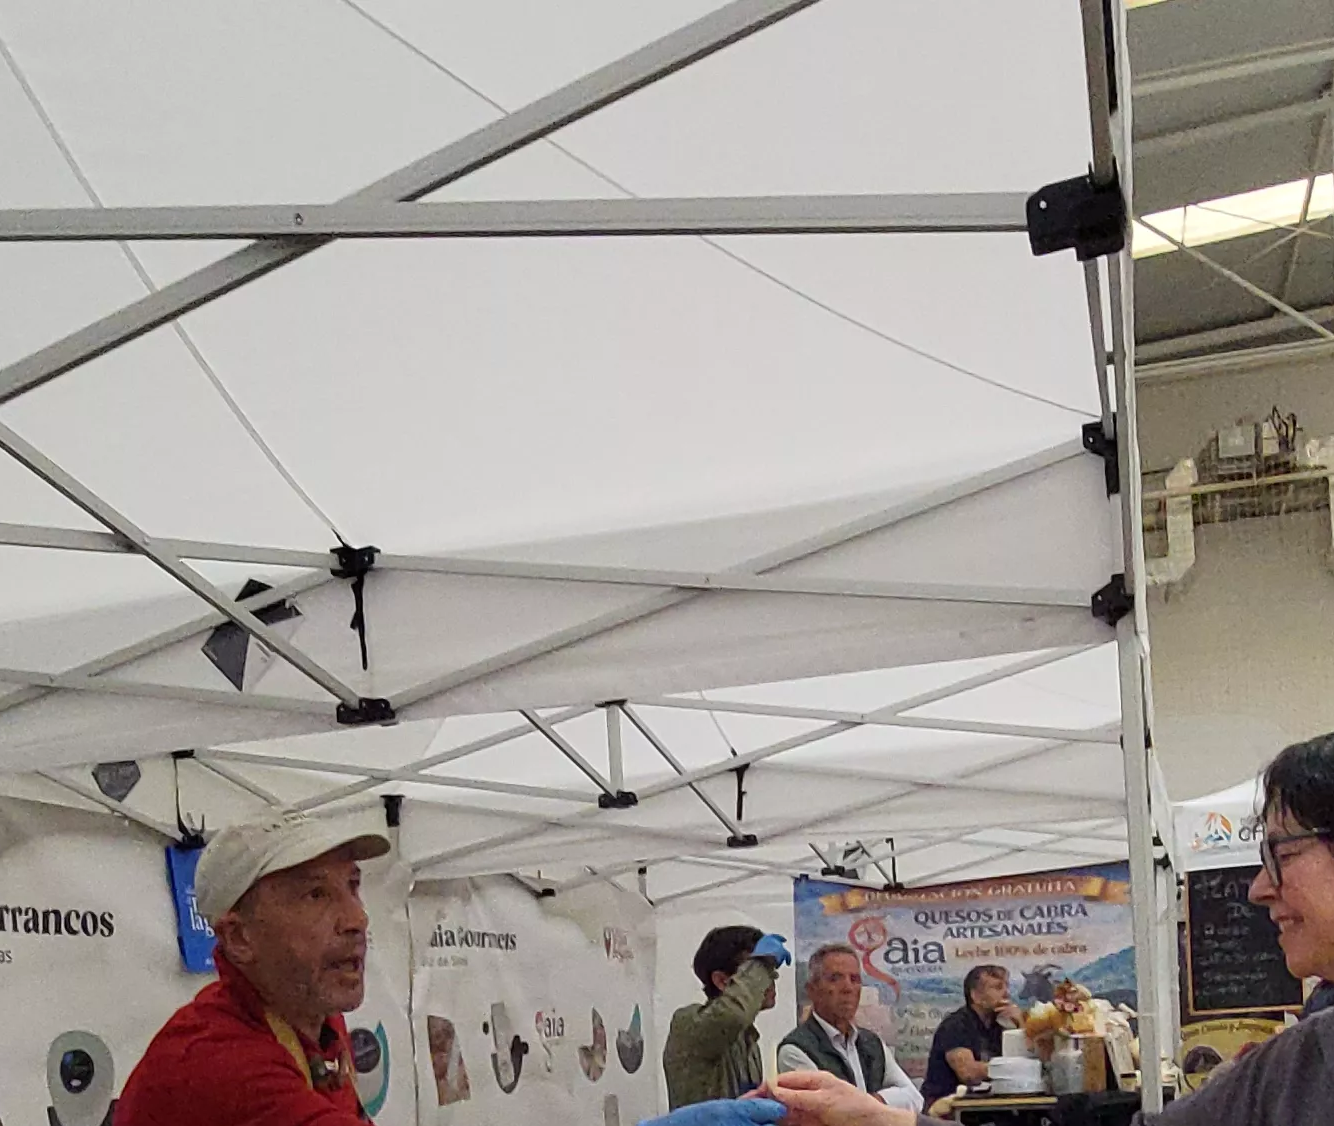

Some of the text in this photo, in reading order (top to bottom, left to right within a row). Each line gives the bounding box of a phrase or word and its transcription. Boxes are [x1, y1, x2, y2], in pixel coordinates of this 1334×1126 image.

[914, 909, 993, 929] QUESOS
[1020, 903, 1089, 920] CABRA
[943, 921, 1069, 940] ARTESANALES
